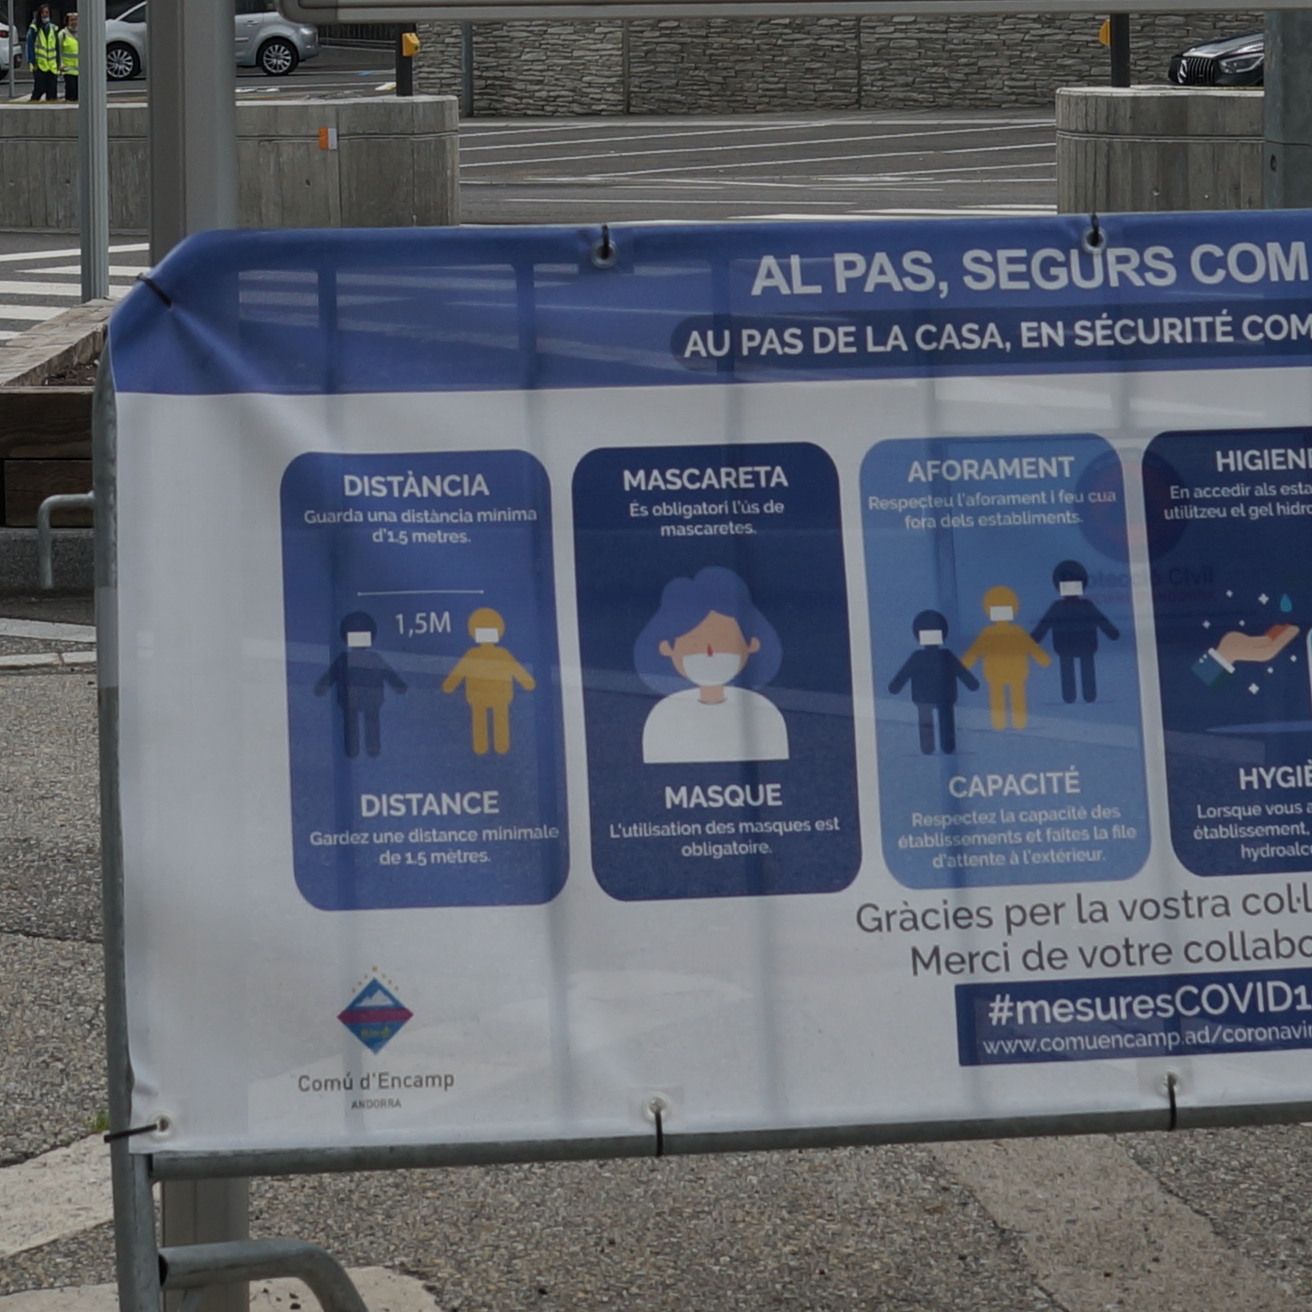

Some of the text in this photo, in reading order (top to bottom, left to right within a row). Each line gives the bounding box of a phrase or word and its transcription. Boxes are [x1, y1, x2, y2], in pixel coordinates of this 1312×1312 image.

[751, 255, 821, 296] AL
[834, 250, 950, 299] PAS,
[961, 244, 1176, 290] SEGURS
[685, 330, 731, 358] AU
[741, 327, 804, 357] PAS
[812, 326, 859, 354] DE
[865, 324, 908, 354] LA
[915, 322, 1013, 354] CASA,
[1021, 319, 1063, 349] EN
[1074, 308, 1232, 349] SÉCURITÉ
[623, 466, 787, 491] MASCARETA
[908, 457, 1075, 482] AFORAMENT
[343, 470, 489, 498] DISTÀNCIA
[1170, 485, 1189, 499] En
[1193, 483, 1250, 499] accedir
[1254, 481, 1276, 496] als
[630, 500, 784, 519] És obligatori l'ús de
[869, 489, 1116, 513] Respecteu l'aforament i feu cua
[1164, 503, 1227, 520] utilitzeu
[1231, 503, 1245, 517] el
[1249, 503, 1273, 521] gel
[304, 507, 537, 524] Guarda una distància mínima
[904, 511, 1083, 530] fora dels establiments.
[413, 530, 471, 544] metres.
[661, 521, 756, 537] mascaretes.
[395, 612, 451, 637] 1,5M
[949, 765, 1081, 799] CAPACITÉ
[361, 791, 499, 817] DISTANCE
[665, 784, 782, 810] MASQUE
[1198, 803, 1261, 822] Lorsque
[1266, 800, 1302, 816] vous
[610, 817, 840, 838] L'utilisation des masques est
[1194, 820, 1310, 840] établissement,
[682, 840, 772, 859] obligatoire.
[856, 898, 994, 934] Gràcies
[1005, 900, 1066, 937] per
[1075, 893, 1110, 925] la
[1118, 889, 1231, 923] vostra
[911, 942, 1011, 977] Merci
[1022, 939, 1070, 973] de
[1078, 934, 1173, 970] votre
[298, 1070, 455, 1092] Comú d'Encamp
[351, 1098, 401, 1110] ANDORRA
